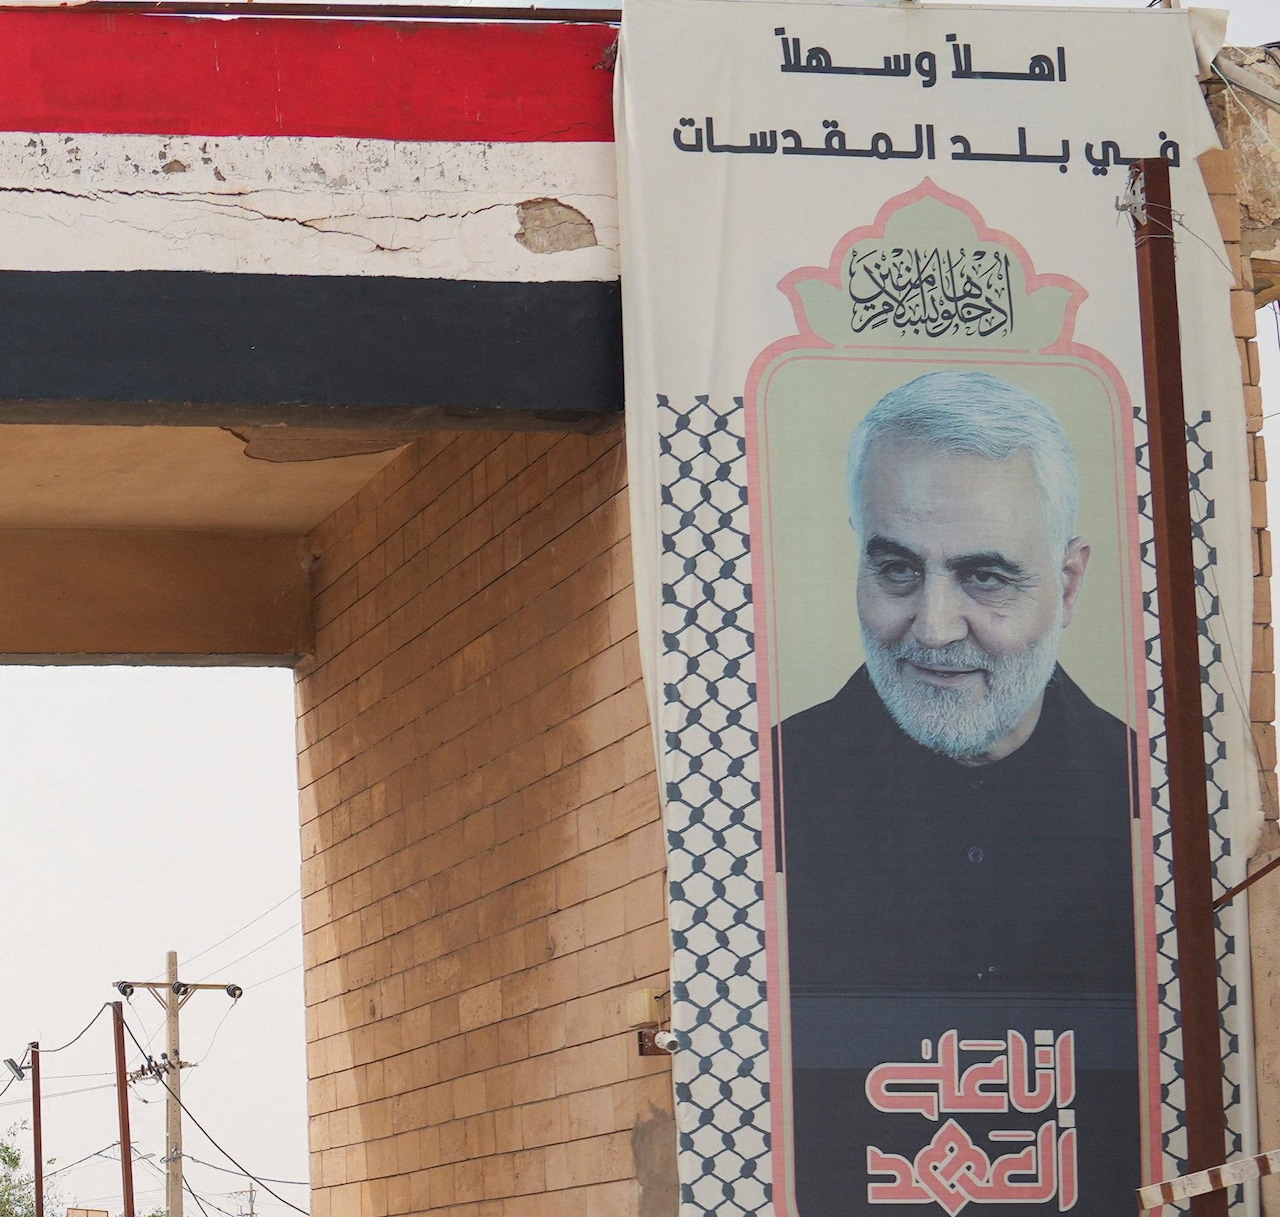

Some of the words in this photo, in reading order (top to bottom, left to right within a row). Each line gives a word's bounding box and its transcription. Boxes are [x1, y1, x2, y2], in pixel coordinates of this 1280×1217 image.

[672, 116, 936, 161] المقدسات
[950, 126, 1071, 174] بلد
[1084, 130, 1181, 177] في
